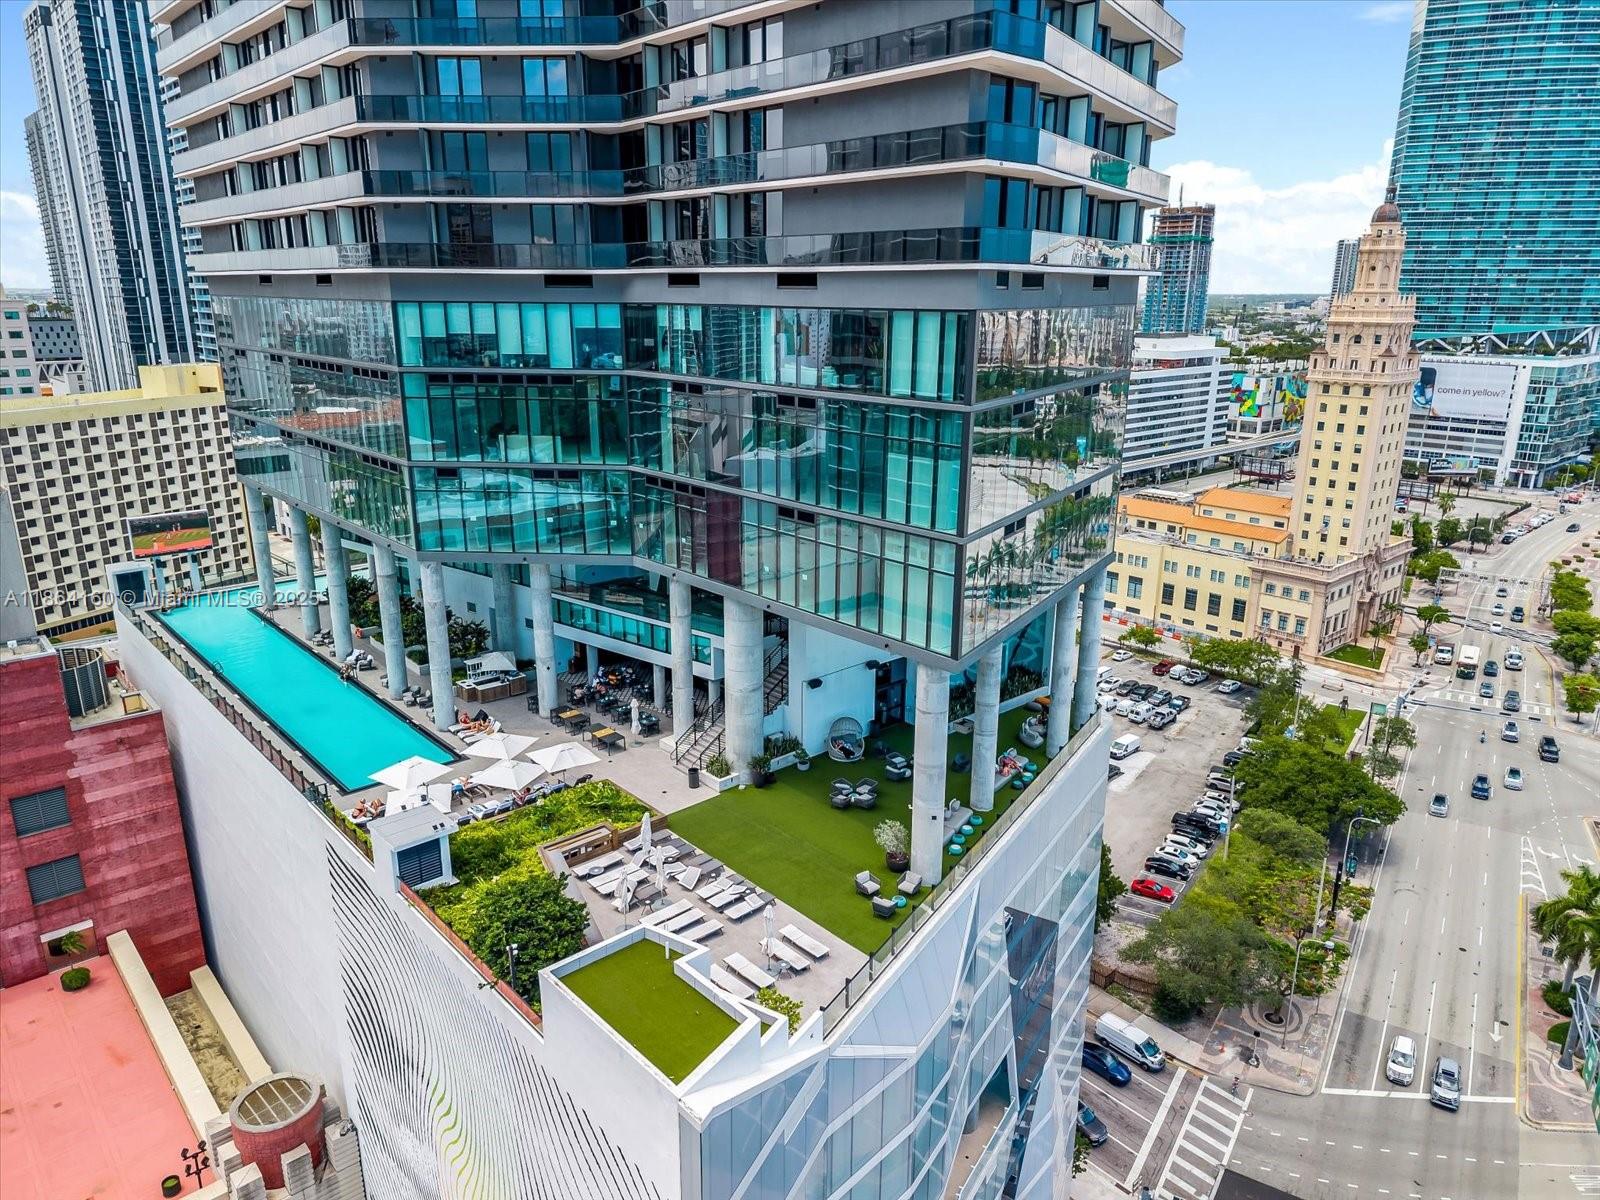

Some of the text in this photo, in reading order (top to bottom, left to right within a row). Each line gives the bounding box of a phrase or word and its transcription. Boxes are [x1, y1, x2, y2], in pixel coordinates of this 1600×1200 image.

[1437, 386, 1506, 398] come in yellow?
